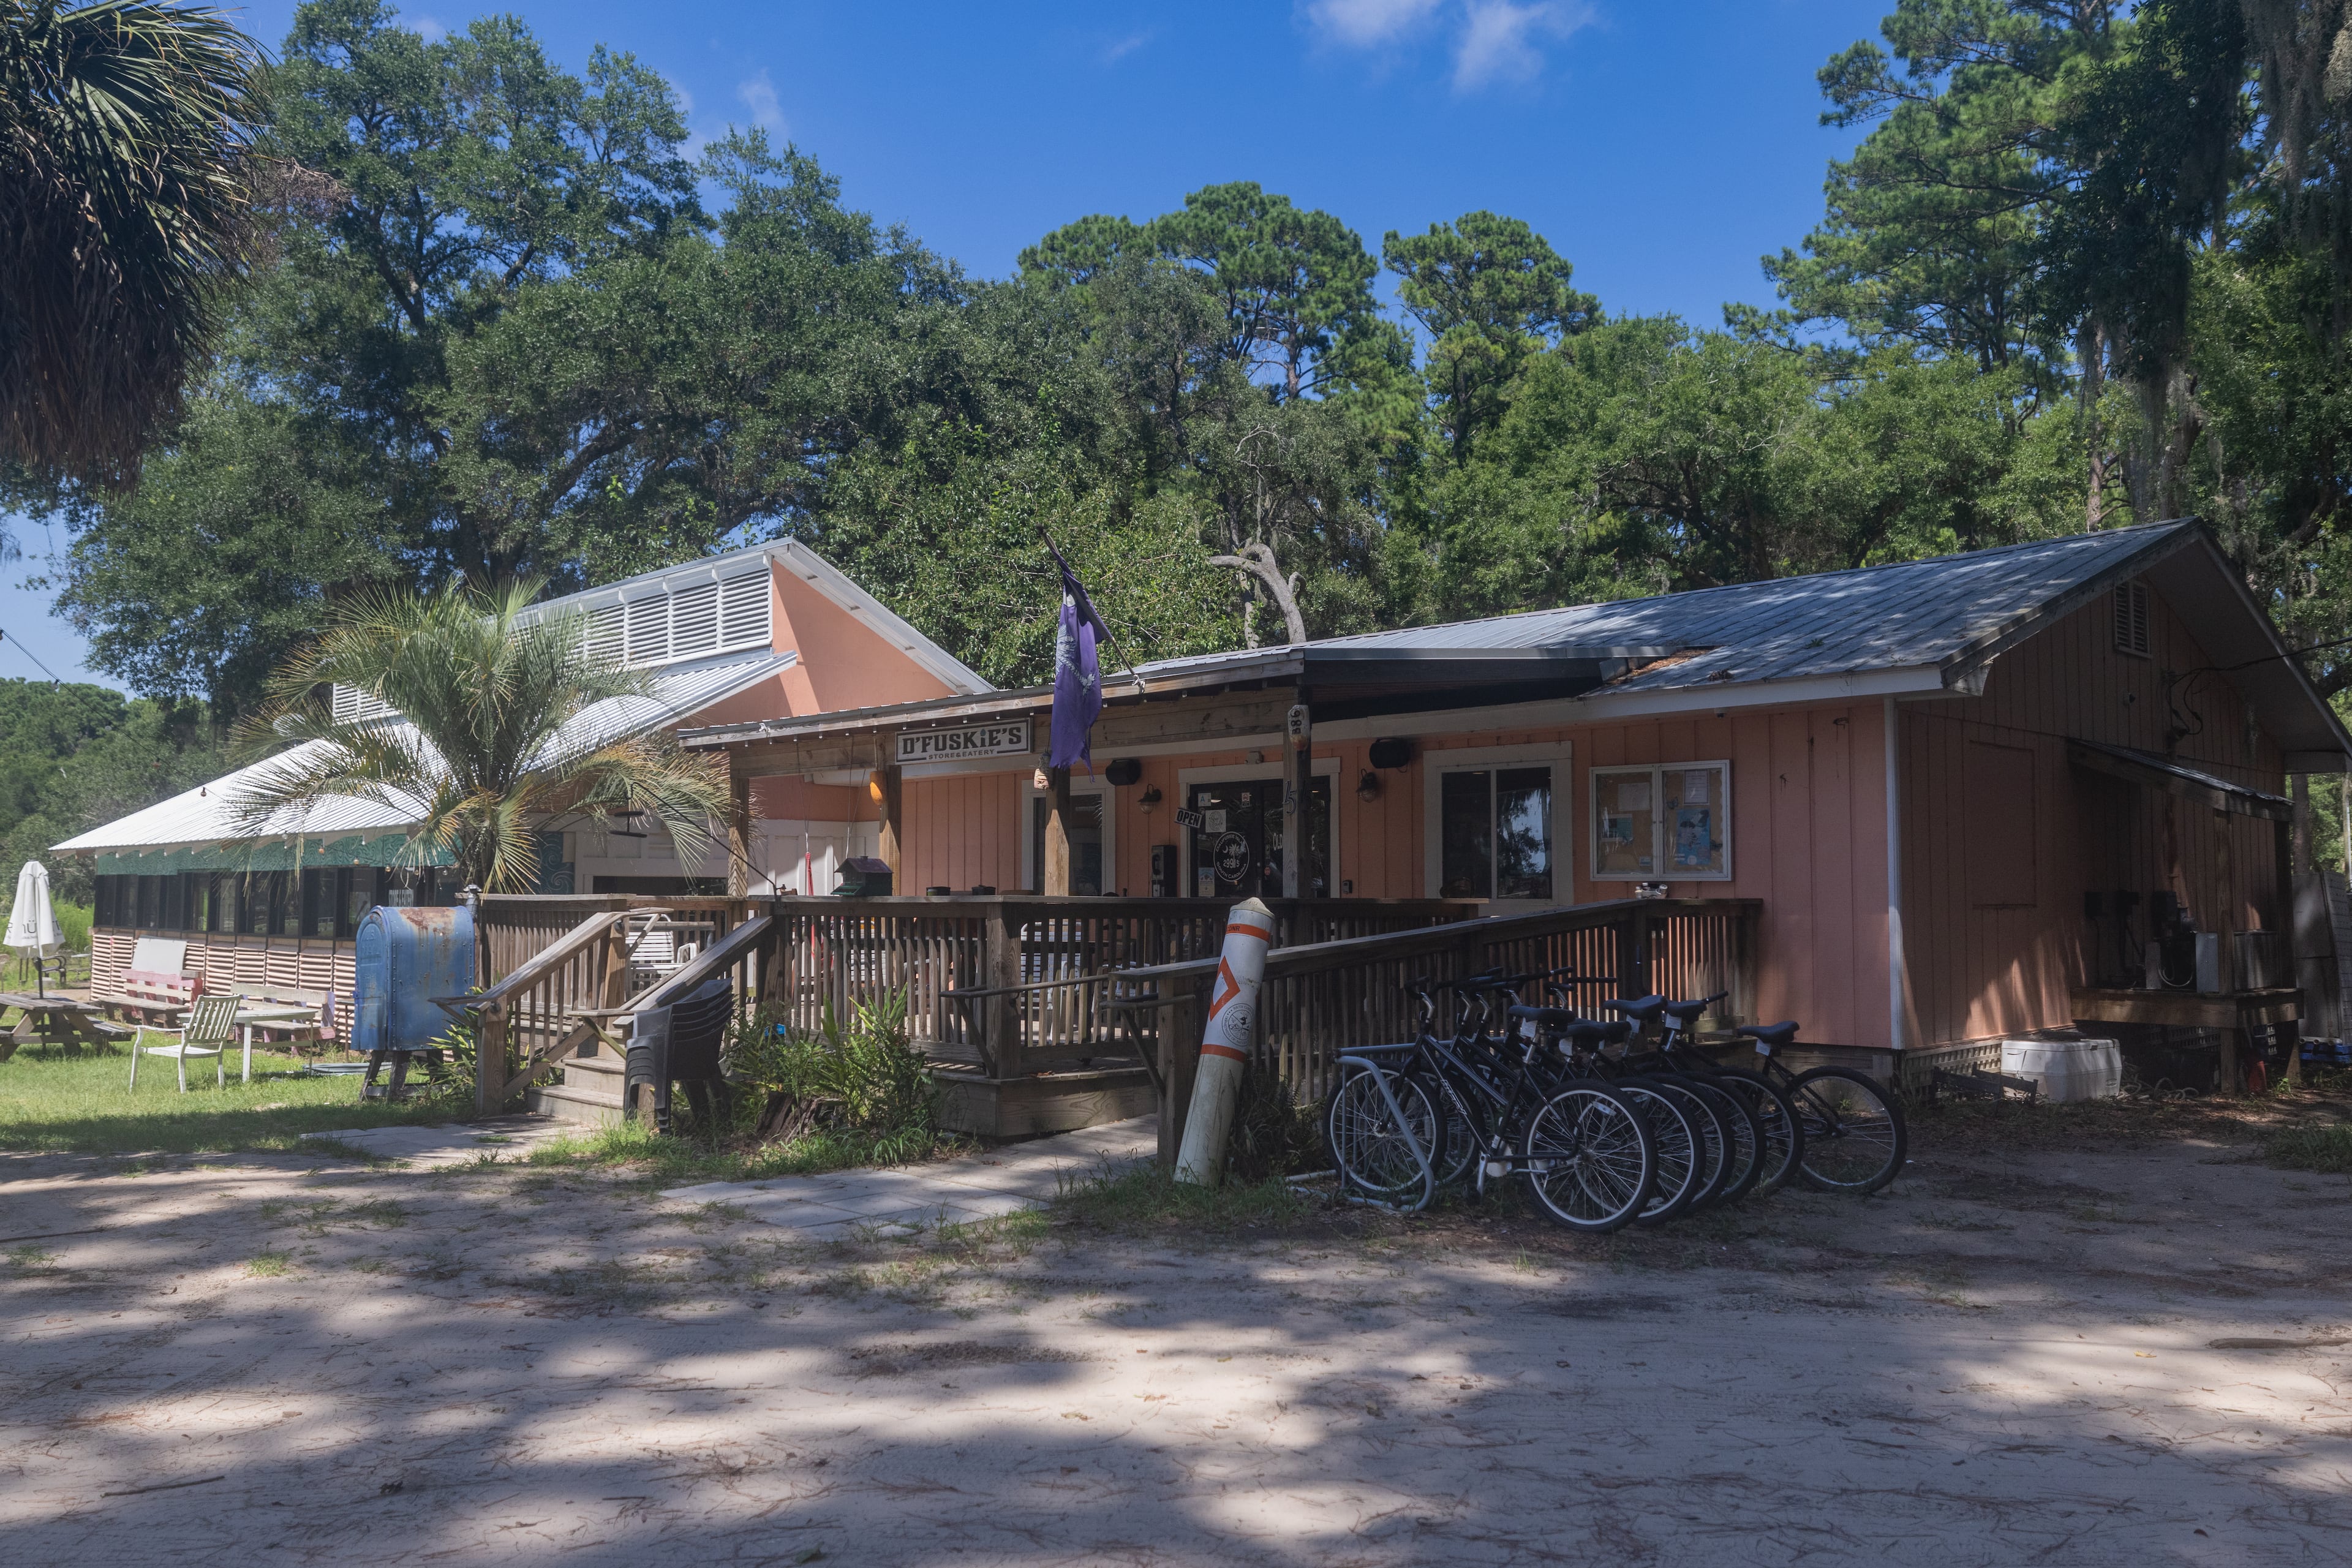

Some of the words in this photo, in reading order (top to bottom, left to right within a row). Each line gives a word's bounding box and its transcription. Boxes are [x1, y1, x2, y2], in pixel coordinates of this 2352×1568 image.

[1283, 780, 1297, 814] 15
[1177, 810, 1200, 827] OPEN
[1273, 832, 1283, 851] OLD
[1216, 861, 1228, 877] SOUTH
[1228, 863, 1247, 878] CAROLINA
